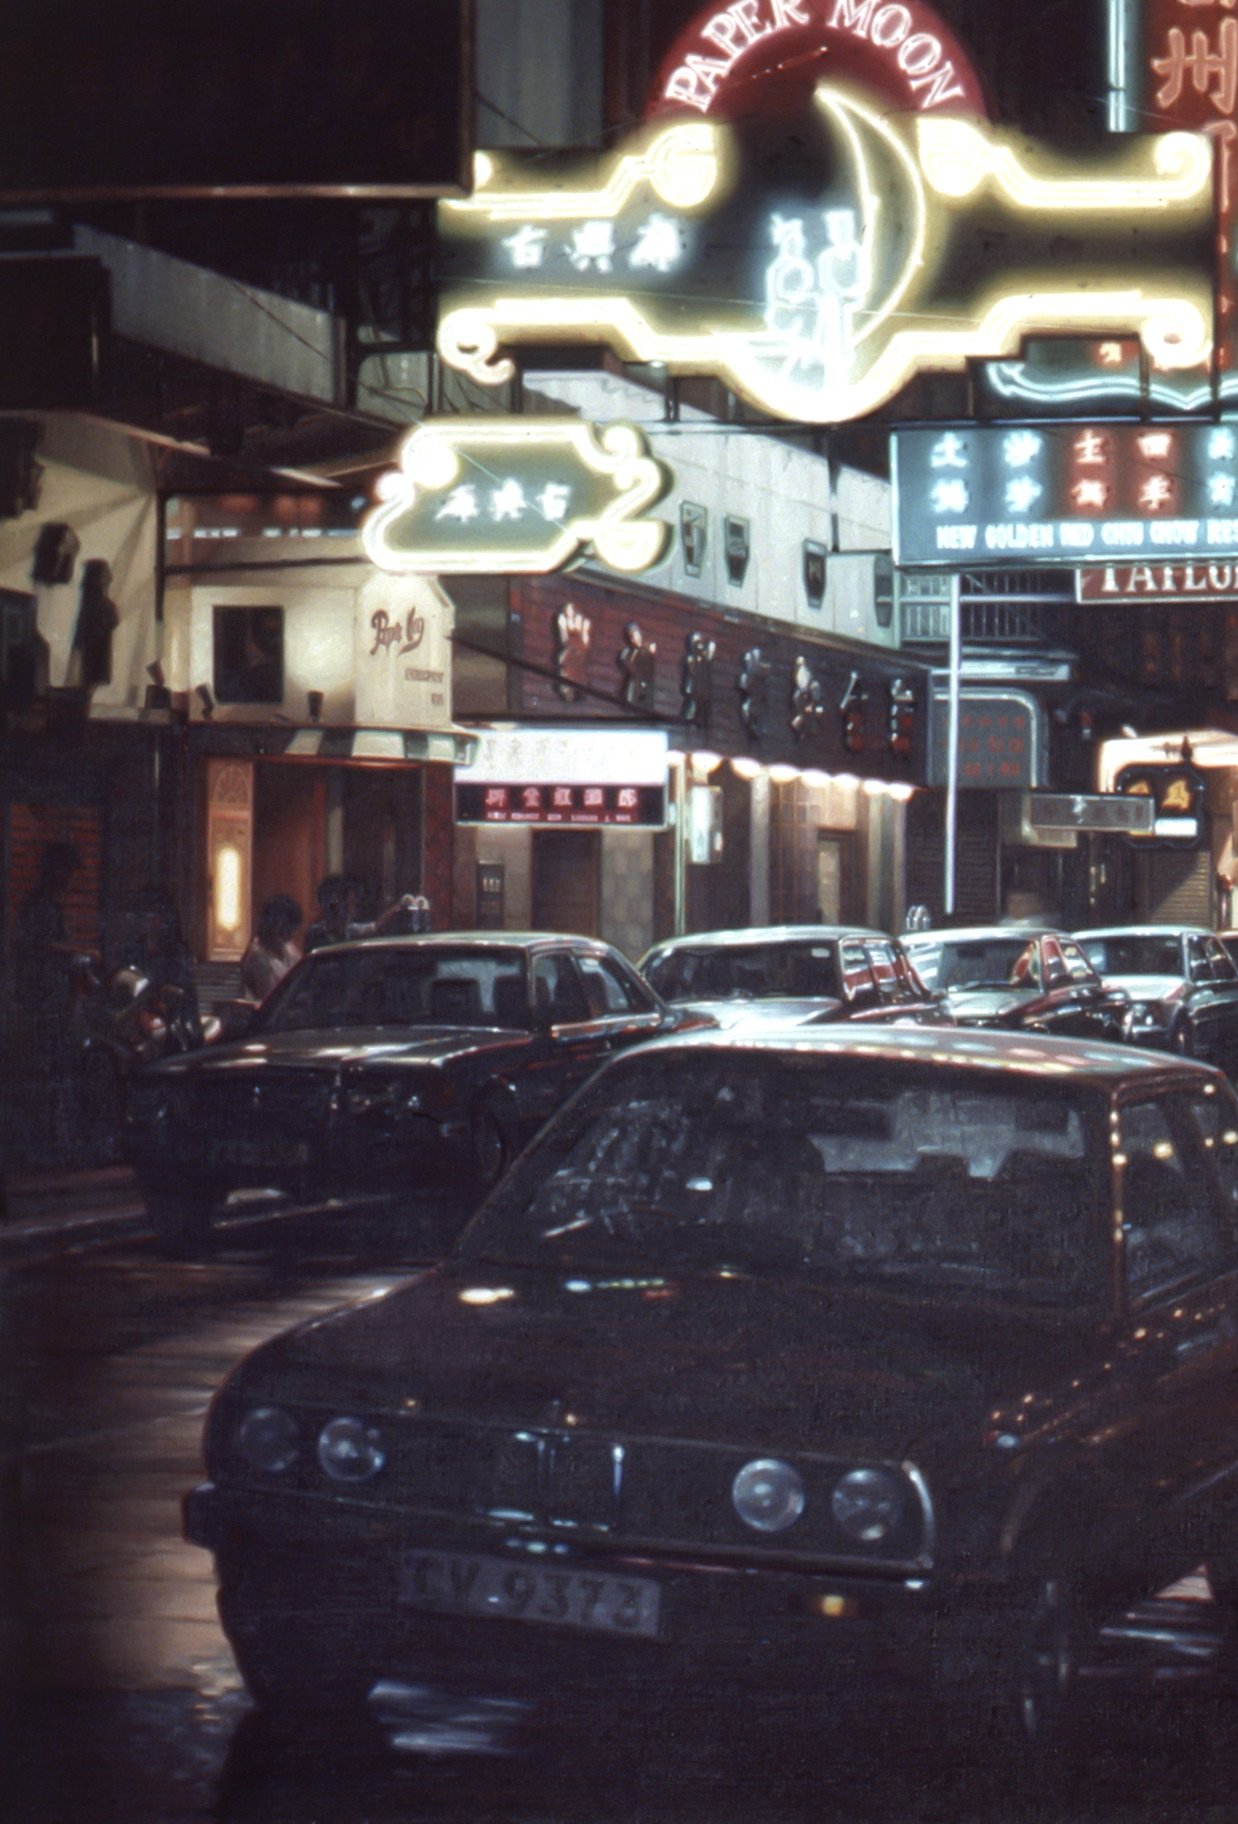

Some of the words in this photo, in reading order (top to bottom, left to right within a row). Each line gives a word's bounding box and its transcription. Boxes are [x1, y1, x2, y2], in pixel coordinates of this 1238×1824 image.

[665, 0, 810, 112] PAPER
[828, 0, 966, 109] MOON
[937, 524, 977, 549] NEW
[985, 523, 1054, 548] GOLDEN
